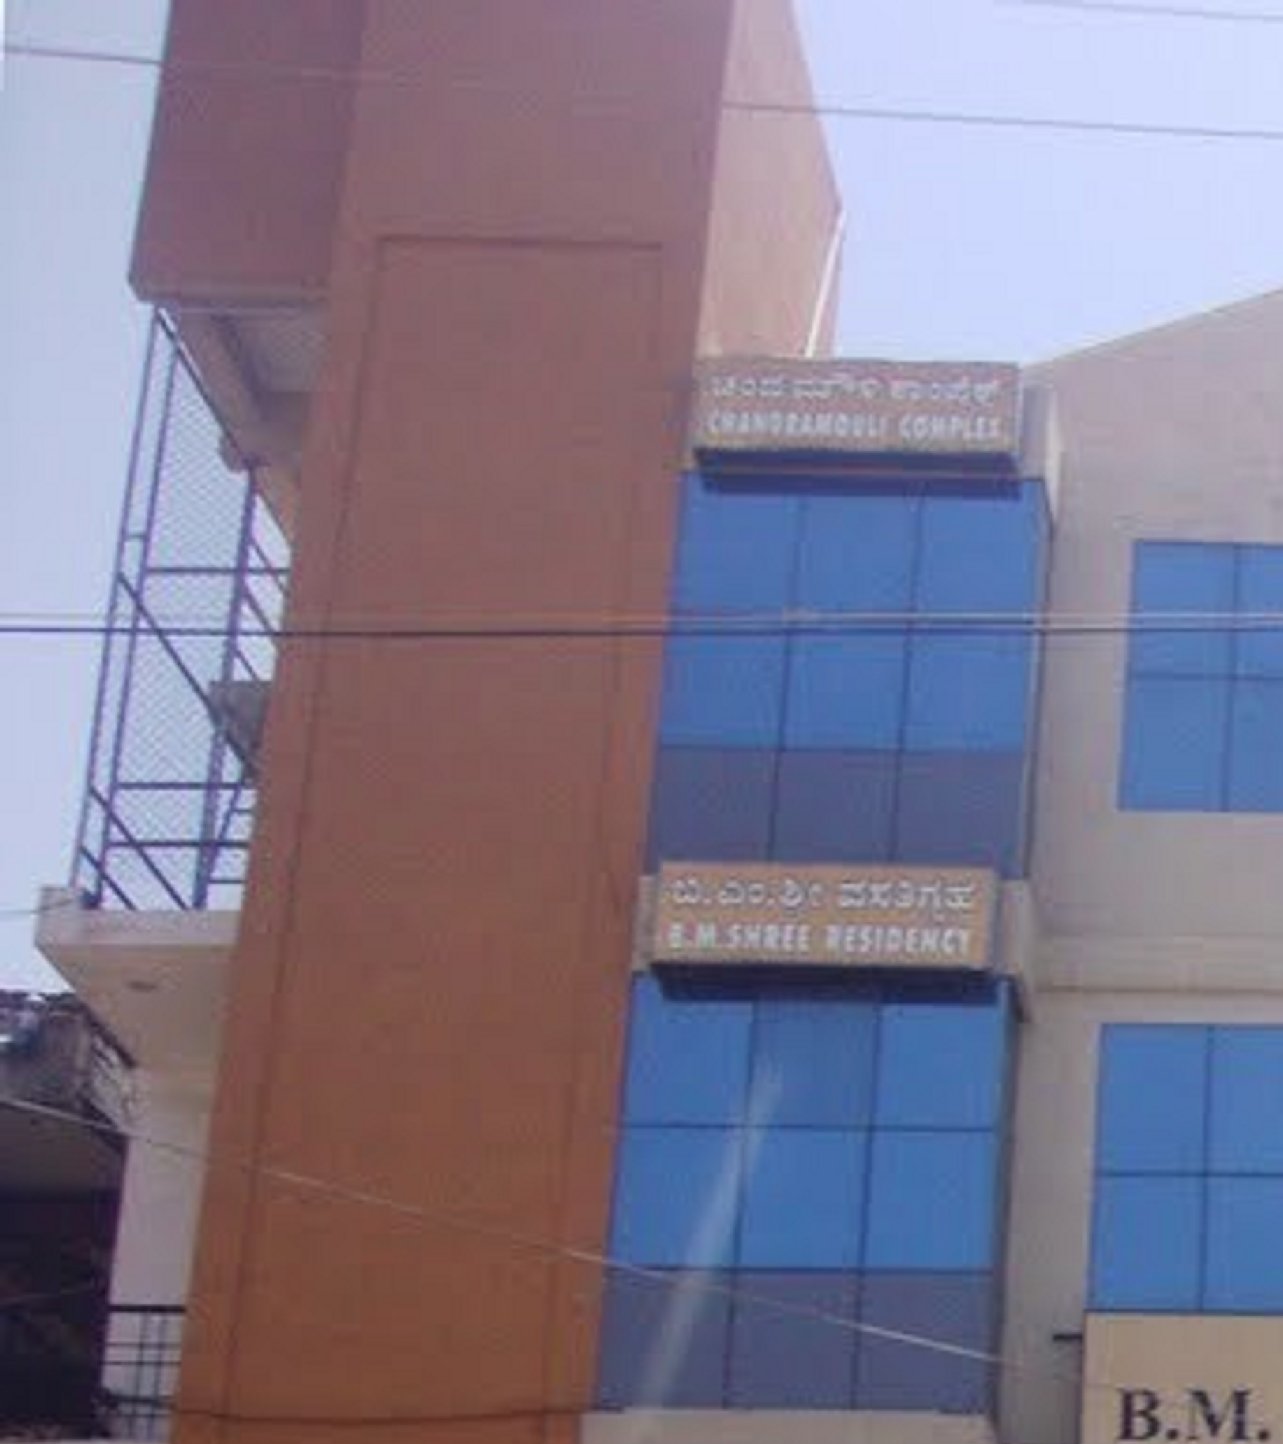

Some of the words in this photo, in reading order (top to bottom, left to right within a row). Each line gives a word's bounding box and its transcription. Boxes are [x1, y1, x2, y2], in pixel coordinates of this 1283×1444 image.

[708, 411, 886, 438] CHANDRAMOULI
[899, 413, 1001, 441] COMPLEX
[826, 924, 971, 953] RESIDENCY
[1115, 1387, 1271, 1442] B.M.
